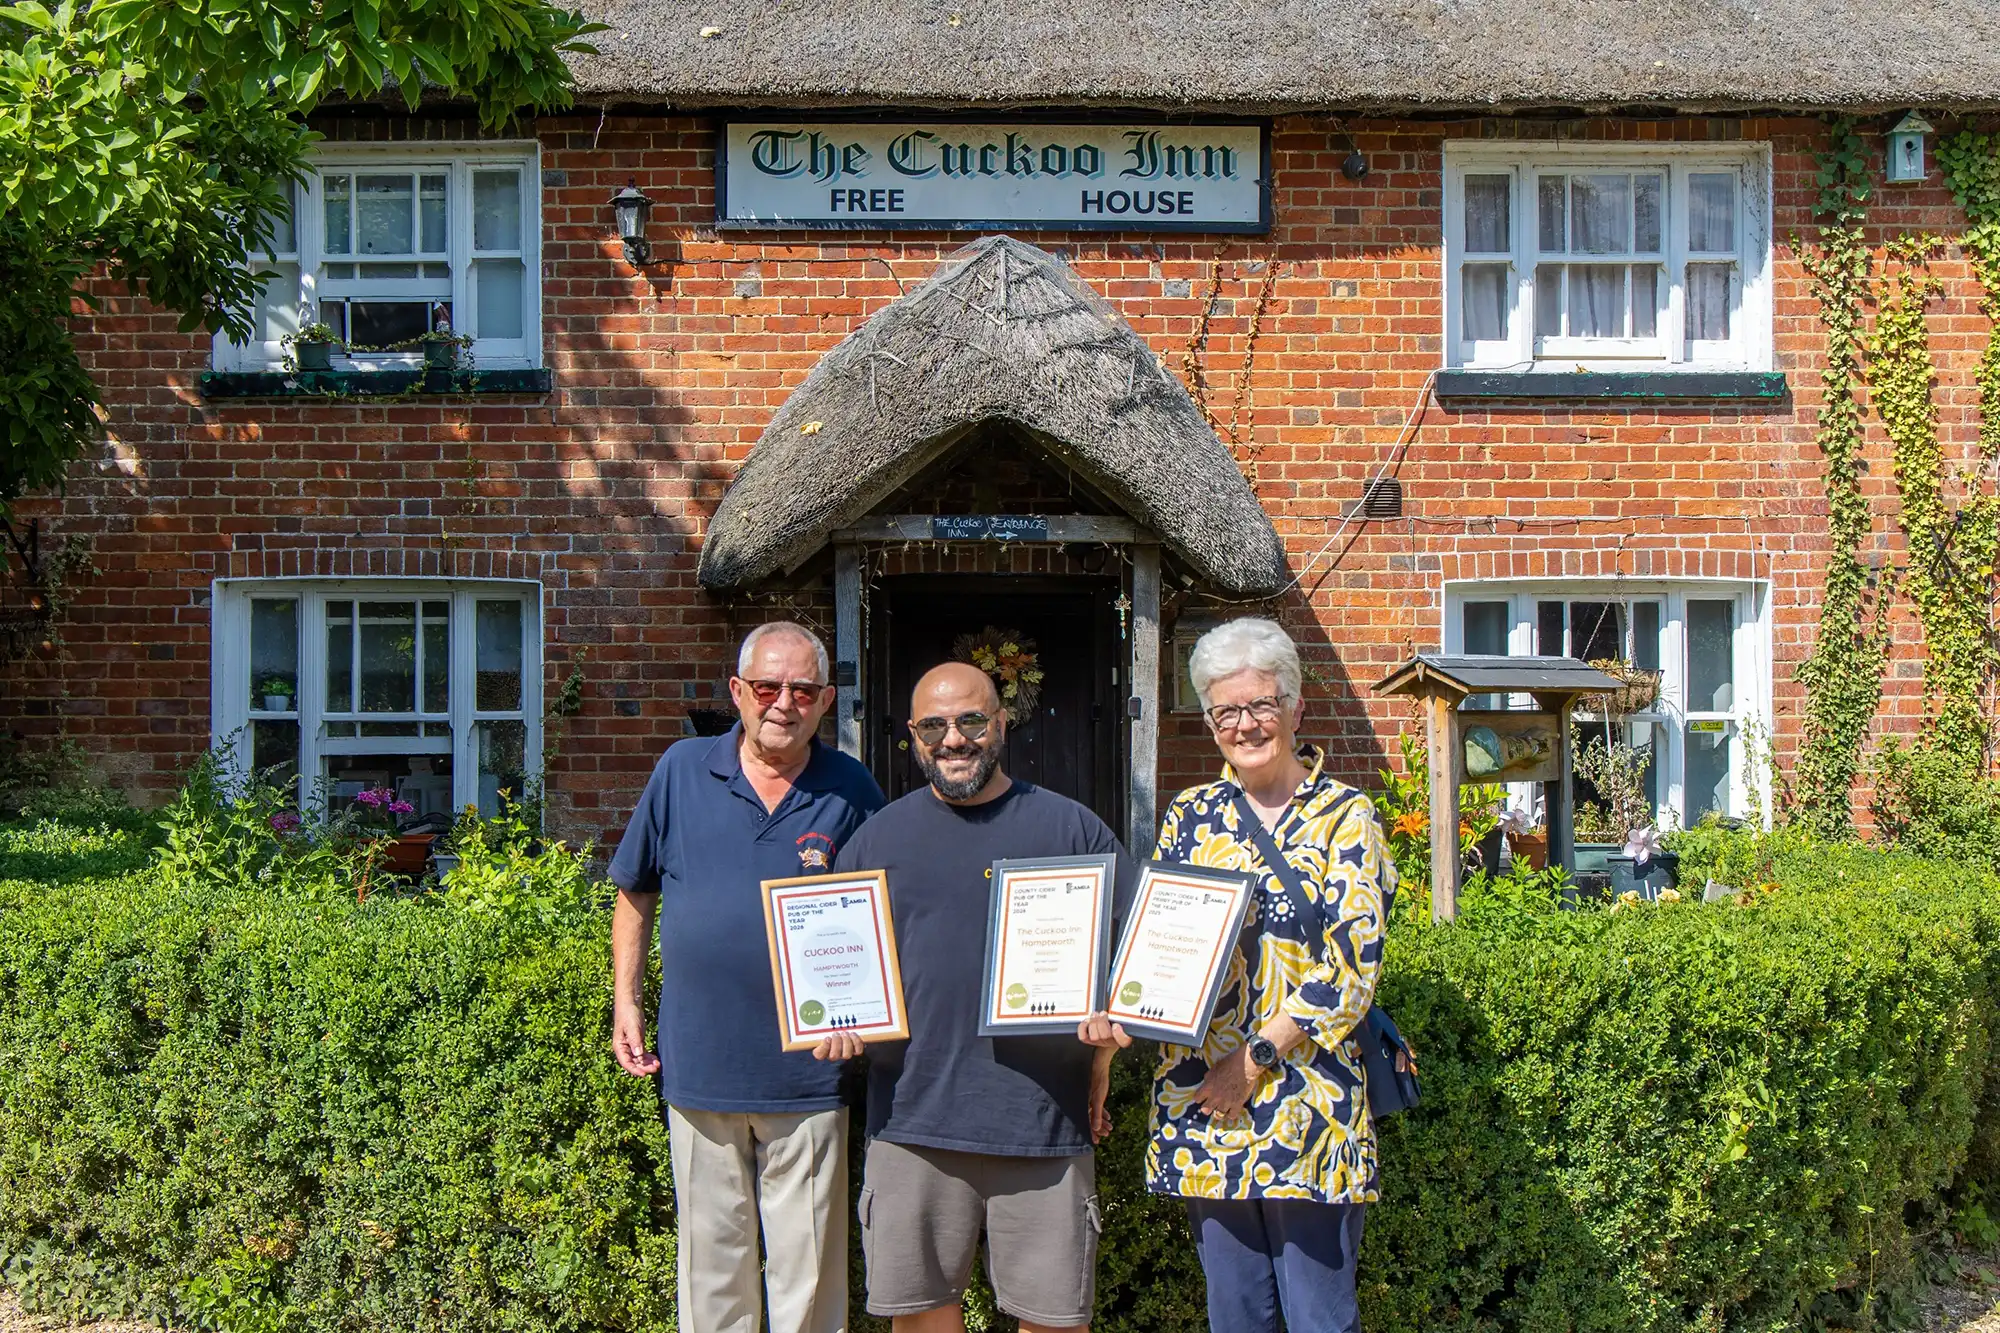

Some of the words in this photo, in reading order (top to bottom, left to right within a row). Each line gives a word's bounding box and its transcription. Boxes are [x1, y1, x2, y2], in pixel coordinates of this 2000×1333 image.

[748, 129, 872, 187] The
[887, 130, 1103, 180] Cuckoo
[1119, 130, 1241, 181] Inn
[830, 189, 905, 212] FREE
[1081, 190, 1194, 214] HOUSE
[935, 518, 953, 527] THE
[1034, 926, 1067, 936] Cuckoo
[1148, 930, 1162, 938] The
[1164, 932, 1194, 943] Cuckoo
[1022, 938, 1076, 948] Hamptworth
[1148, 942, 1199, 955] Hamptworth
[804, 946, 845, 958] CUCKOO
[814, 963, 859, 972] HAMPTWORTH
